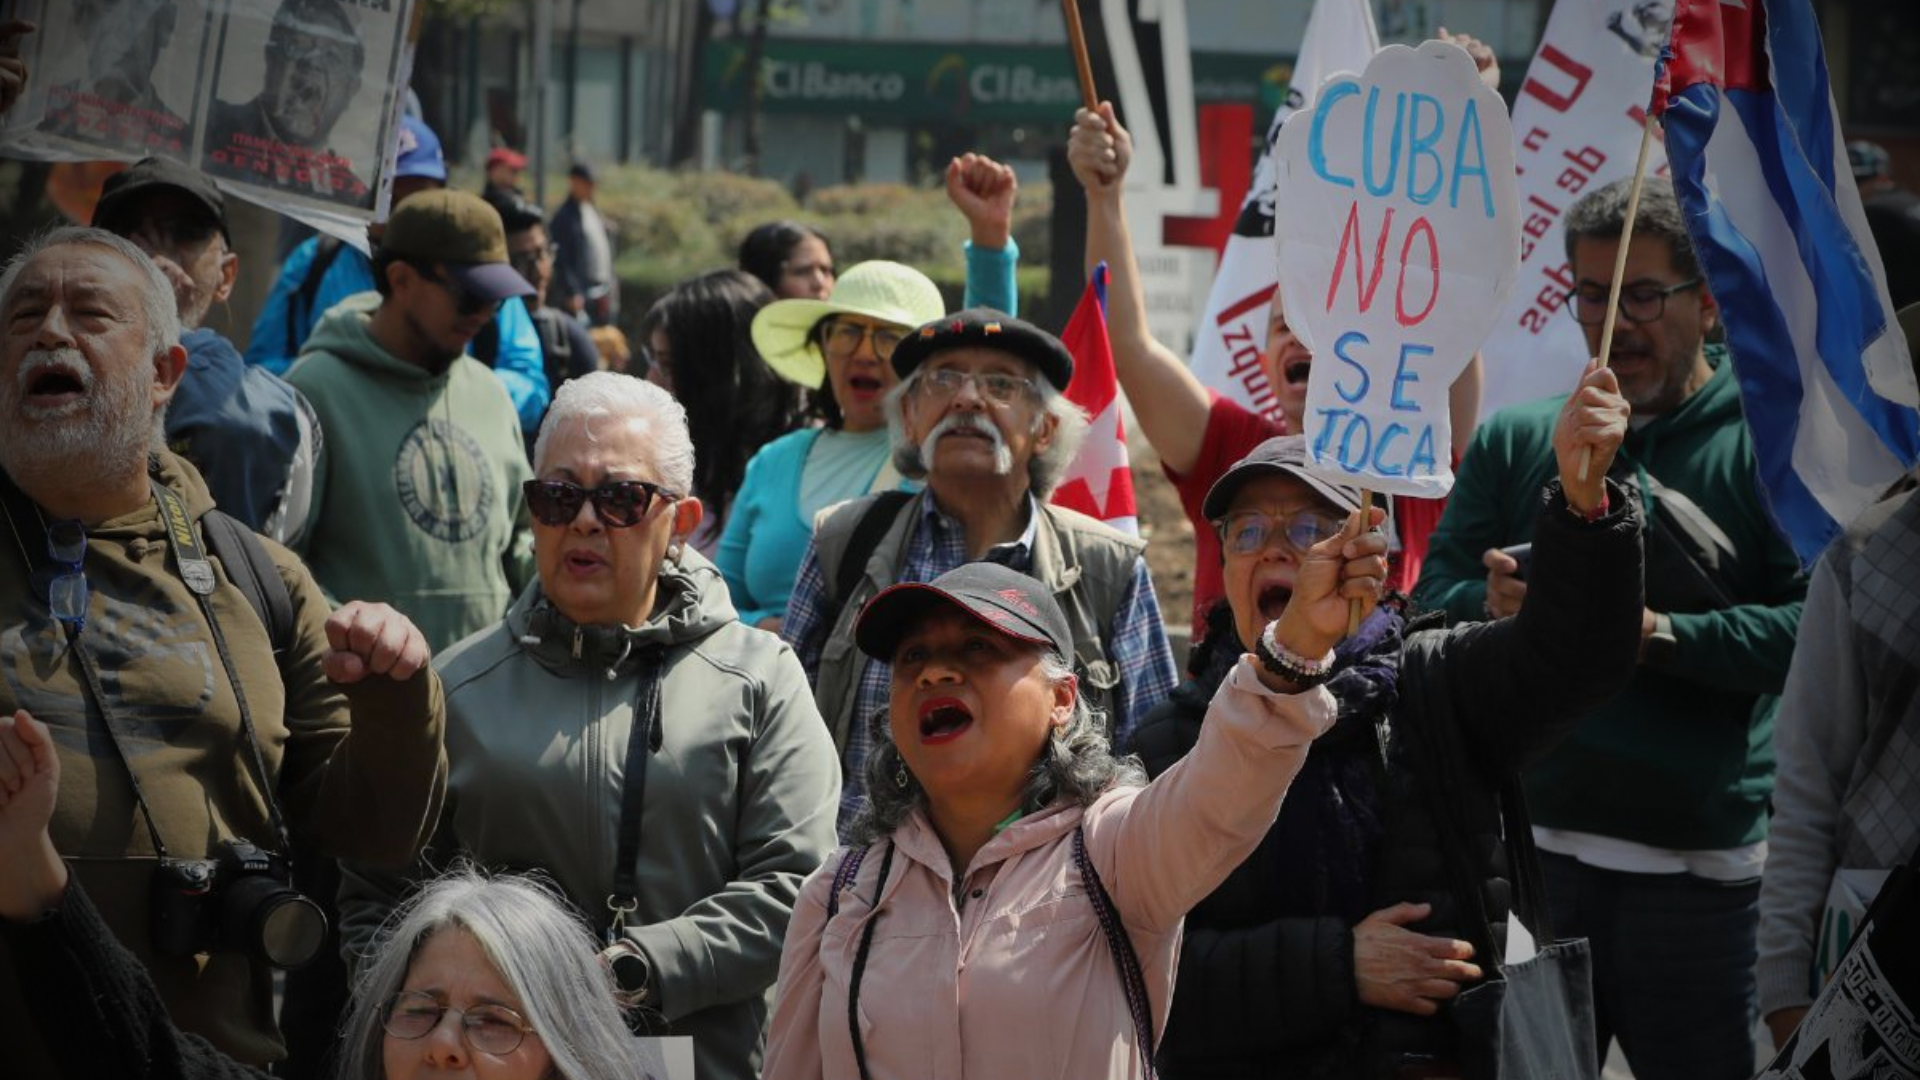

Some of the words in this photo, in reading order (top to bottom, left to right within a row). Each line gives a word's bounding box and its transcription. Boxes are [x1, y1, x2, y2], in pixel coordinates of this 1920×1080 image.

[970, 63, 1081, 101] CIBan
[1307, 80, 1495, 218] CUBA
[1326, 200, 1440, 327] NO
[1334, 331, 1434, 412] SE
[1312, 408, 1436, 480] TOCA
[164, 494, 194, 547] Nikon
[244, 862, 269, 870] Nikon
